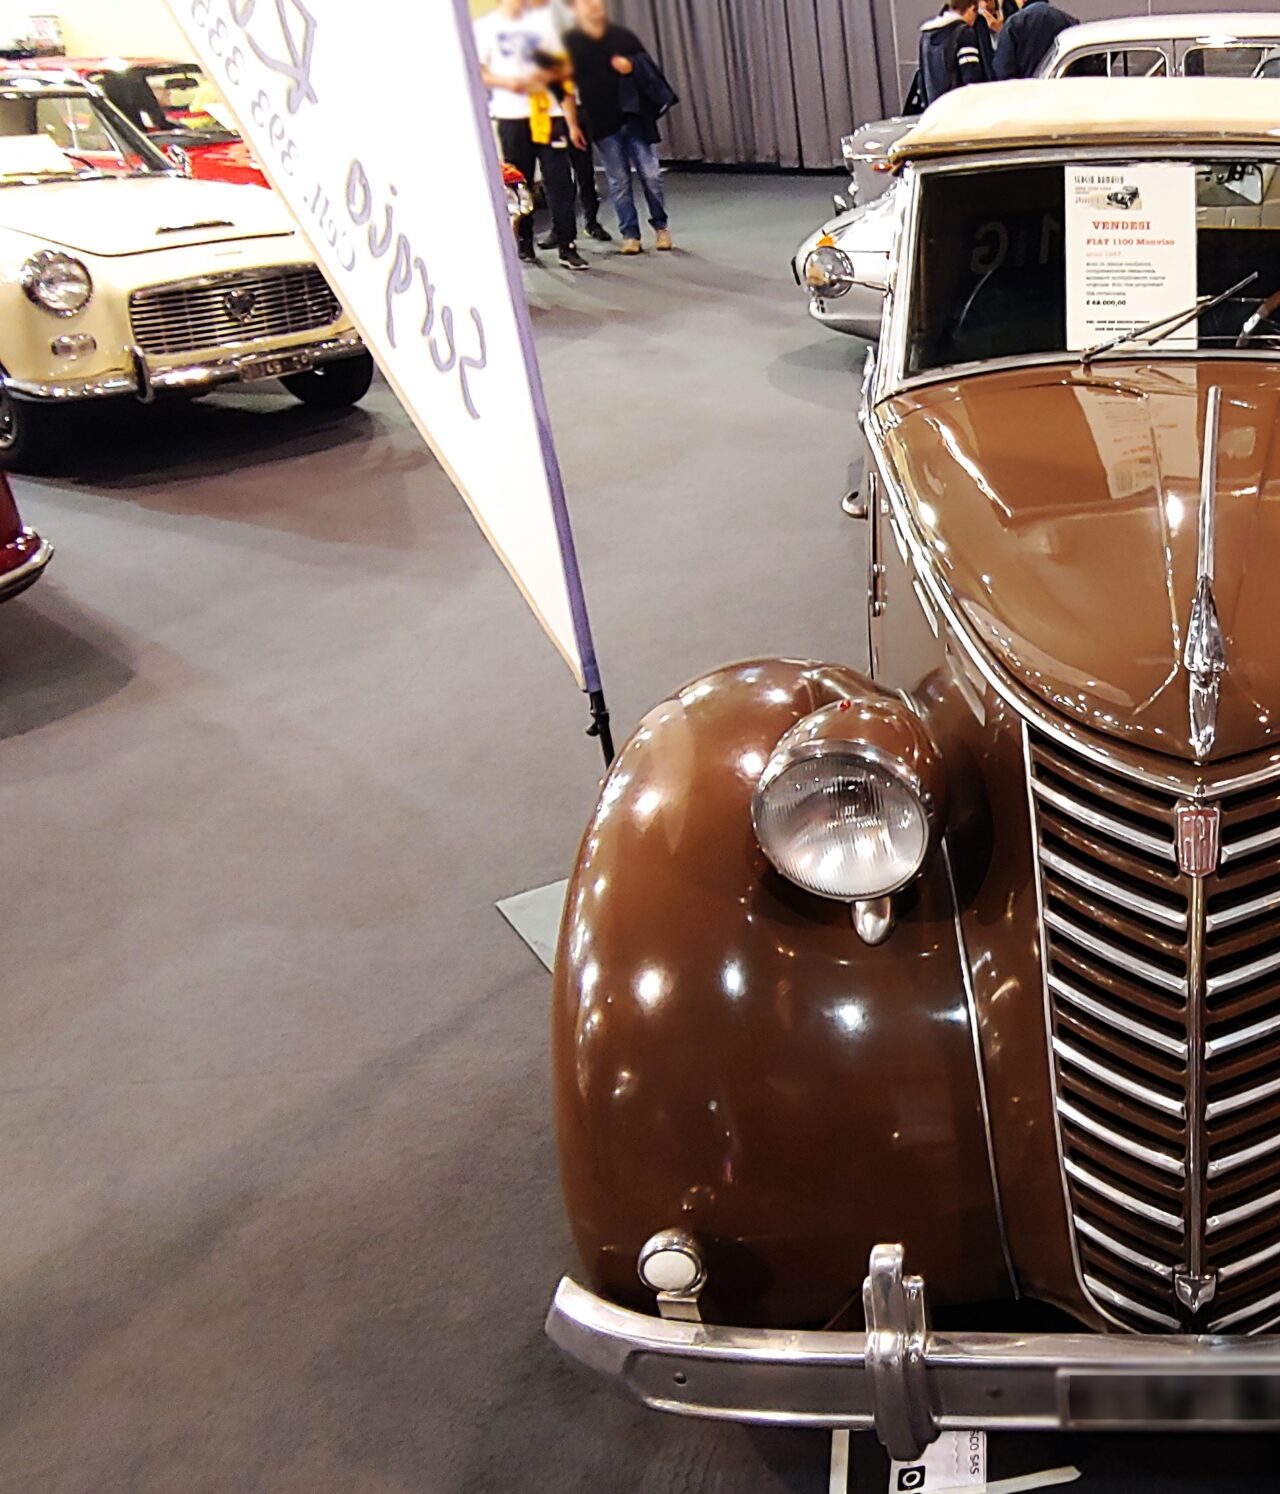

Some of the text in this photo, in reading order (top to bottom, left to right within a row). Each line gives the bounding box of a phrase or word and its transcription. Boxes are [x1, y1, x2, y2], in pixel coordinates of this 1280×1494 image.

[1092, 221, 1151, 230] VENDESI
[1086, 238, 1110, 246] FIAT
[1113, 238, 1134, 246] 1100
